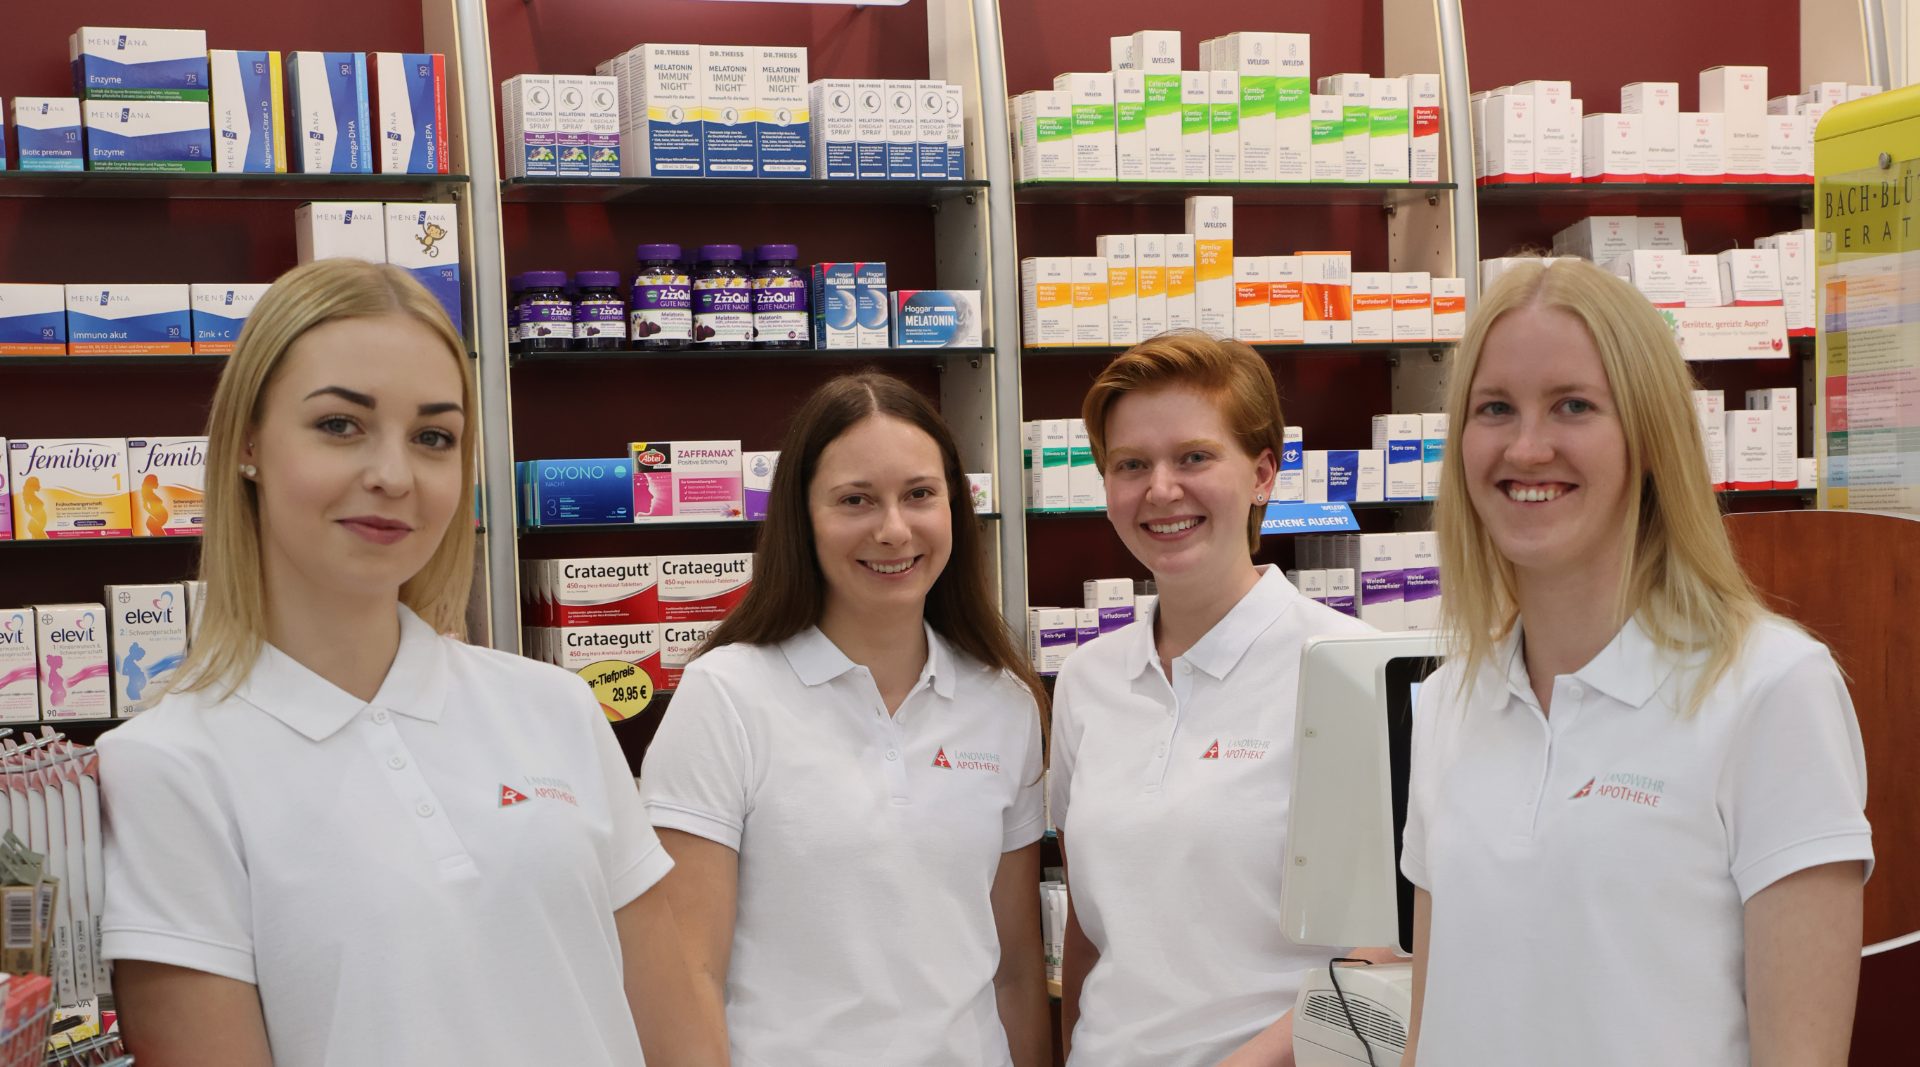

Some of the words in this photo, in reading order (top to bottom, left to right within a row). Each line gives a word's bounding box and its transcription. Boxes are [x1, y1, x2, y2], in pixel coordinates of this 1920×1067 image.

[88, 35, 148, 50] MENSSANA
[255, 63, 264, 74] 60
[341, 64, 350, 75] 90
[420, 66, 428, 77] 90
[90, 75, 122, 84] Enzyme
[186, 74, 197, 83] 75
[91, 108, 151, 122] MENSSANA
[65, 132, 76, 141] 10
[189, 145, 200, 154] 75
[348, 120, 358, 169] Omega-DHA
[426, 123, 434, 170] Omega-EPA
[22, 148, 40, 156] Biotic
[42, 149, 72, 157] premium
[93, 147, 125, 158] Enzyme
[316, 210, 373, 224] MENSSANA
[757, 292, 796, 304] ZzzQuil
[904, 306, 932, 314] Hoggar
[905, 315, 954, 326] MELATONIN
[1744, 320, 1769, 328] Augen?
[42, 328, 54, 338] 90
[109, 330, 128, 339] akut
[168, 327, 180, 336] 30
[198, 330, 216, 338] Zink
[224, 330, 230, 338] C
[642, 454, 661, 462] Abtei
[678, 449, 734, 458] ZAFFRANAX
[20, 445, 117, 476] femibion
[700, 458, 728, 466] Stimmung
[544, 466, 604, 480] OYONO
[112, 473, 122, 491] 1
[546, 498, 557, 516] 3
[1308, 516, 1349, 527] AUGEN?
[564, 562, 649, 580] Crataegutt
[662, 560, 745, 578] Crataegutt
[125, 608, 174, 624] elevit
[50, 628, 95, 642] elevit
[128, 628, 182, 636] Schwangerschaft
[566, 630, 652, 648] Crataegutt
[569, 650, 581, 658] 450
[612, 686, 638, 703] 29,95
[640, 685, 647, 699] €
[46, 709, 56, 717] 90
[954, 750, 1000, 762] LANDWEHR
[1224, 748, 1266, 760] APOTHEKE
[956, 761, 1000, 774] APOTHEKE
[1595, 784, 1662, 808] APOTHEKE
